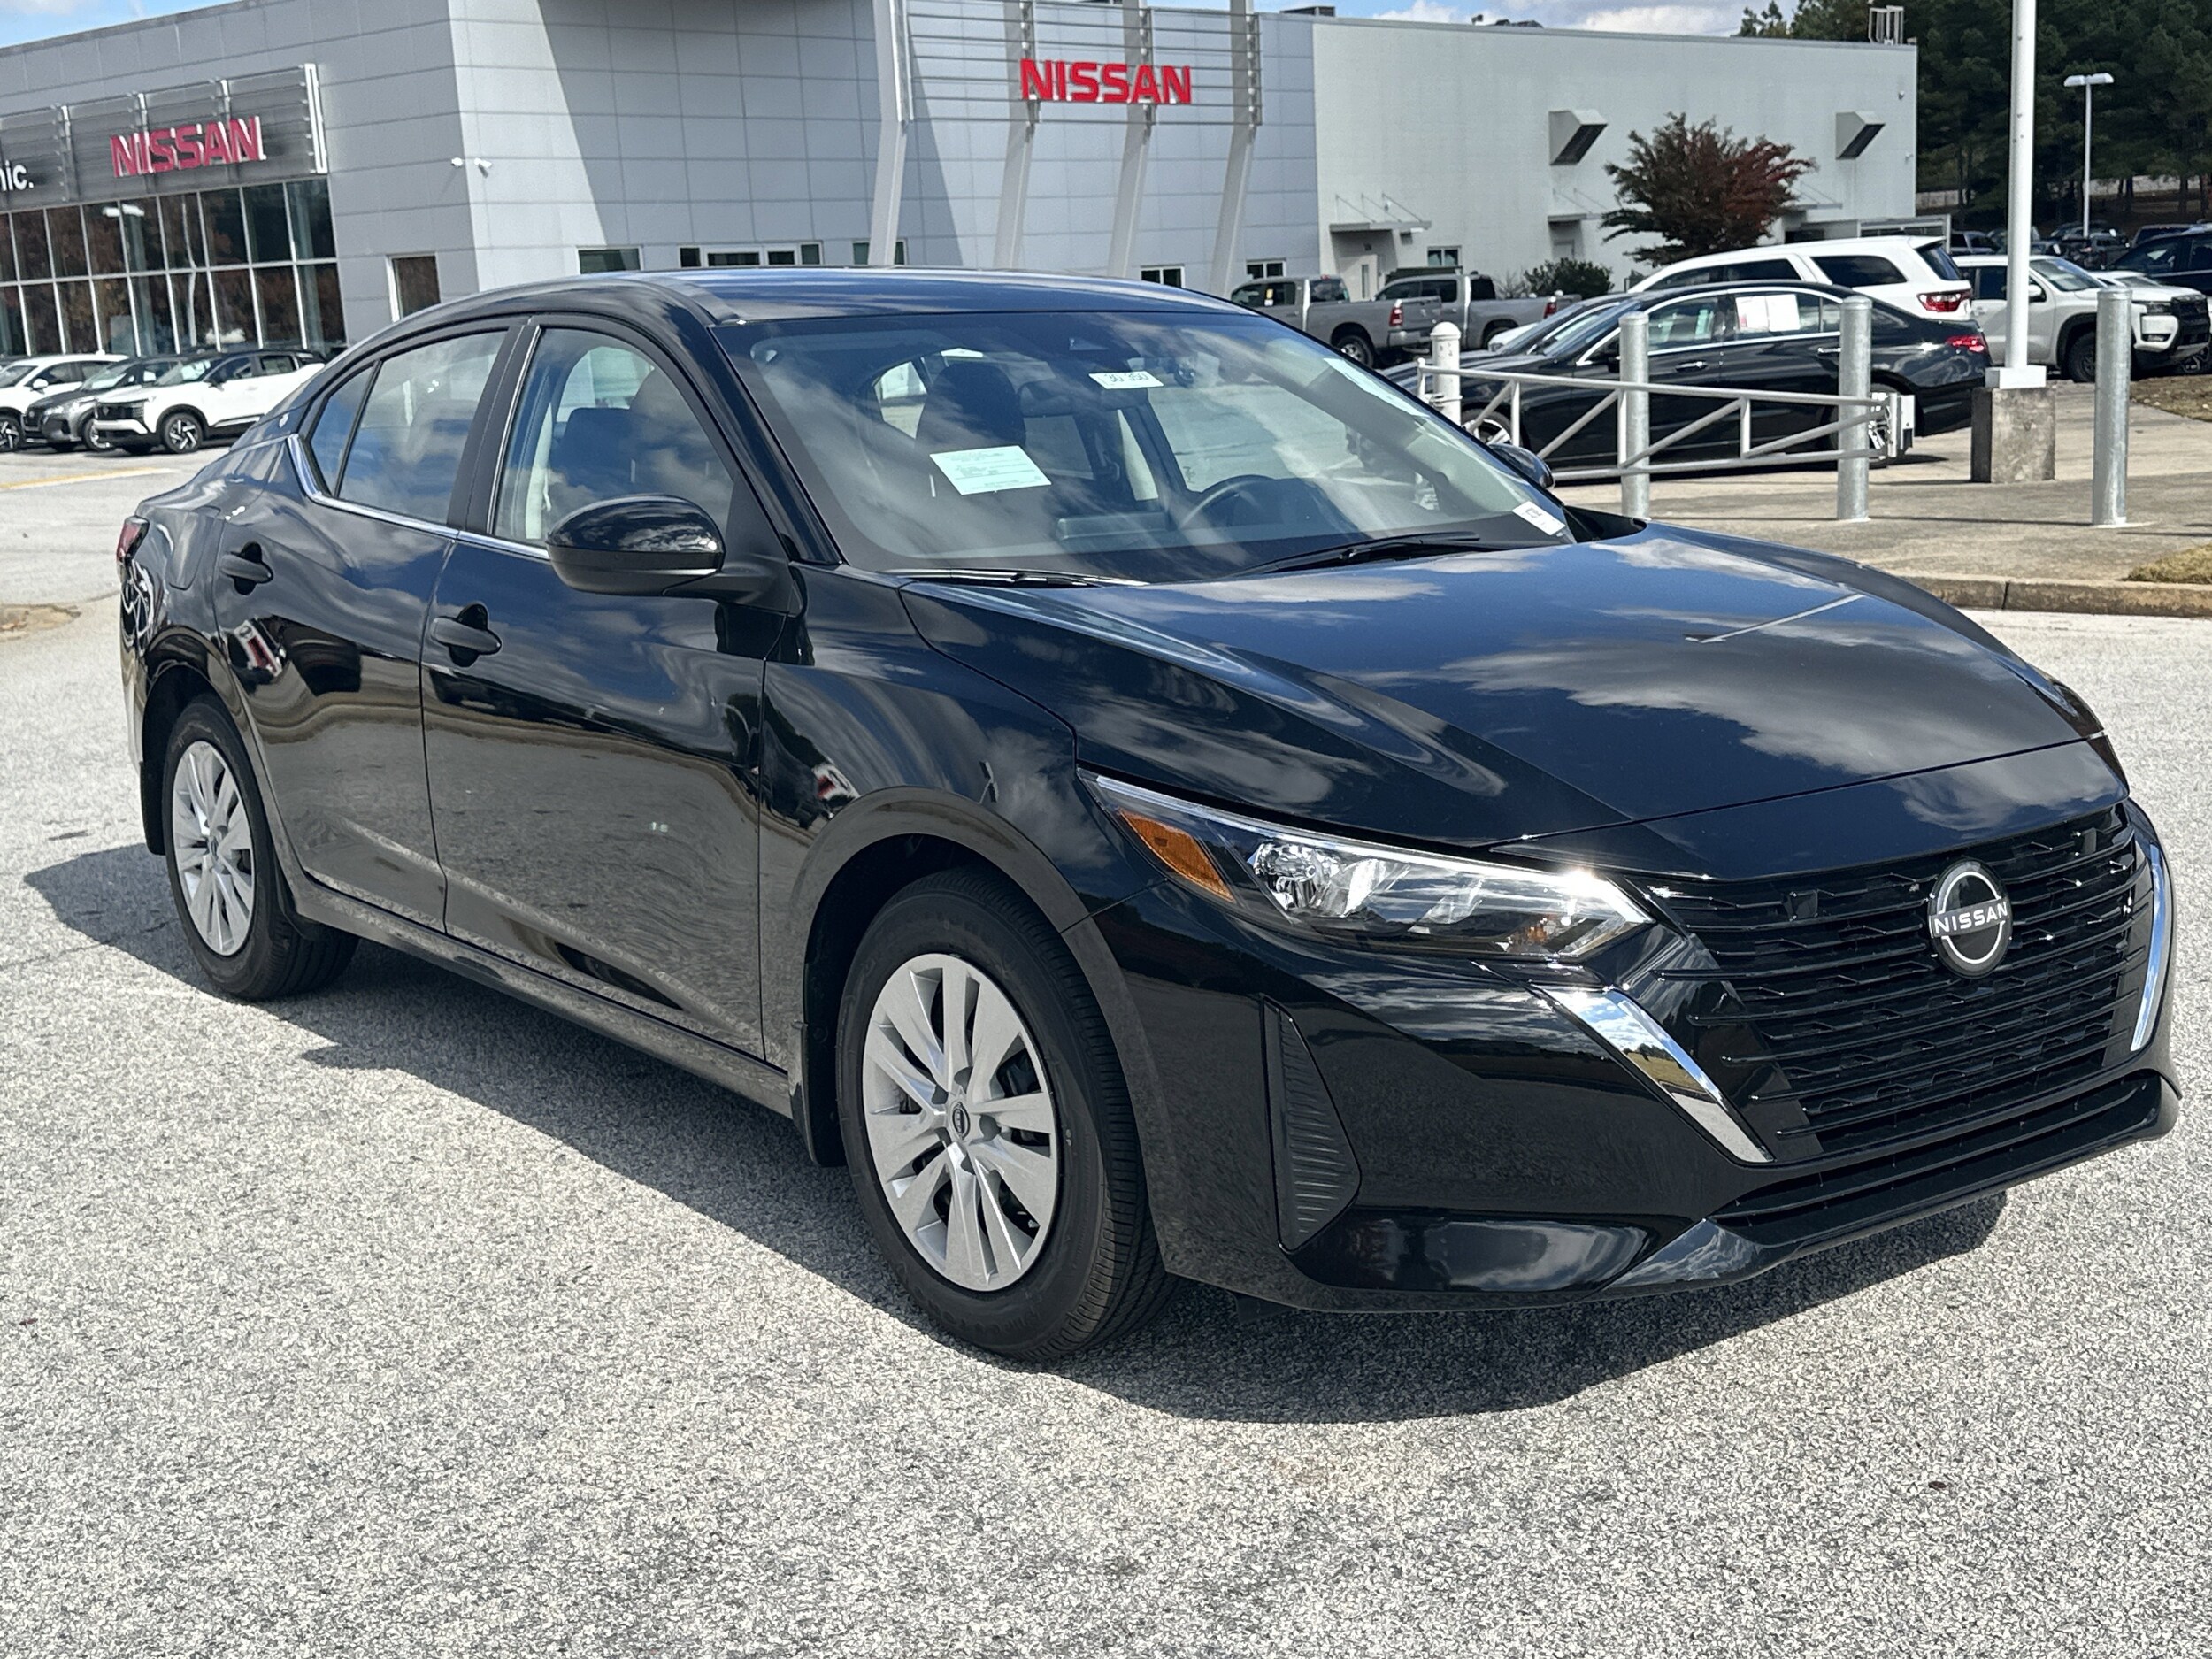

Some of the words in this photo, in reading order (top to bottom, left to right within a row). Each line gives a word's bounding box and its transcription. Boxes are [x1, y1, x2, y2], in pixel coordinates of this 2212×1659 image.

[1020, 58, 1192, 104] NISSAN
[110, 115, 266, 177] NISSAN
[1933, 901, 2008, 934] NISSAN
